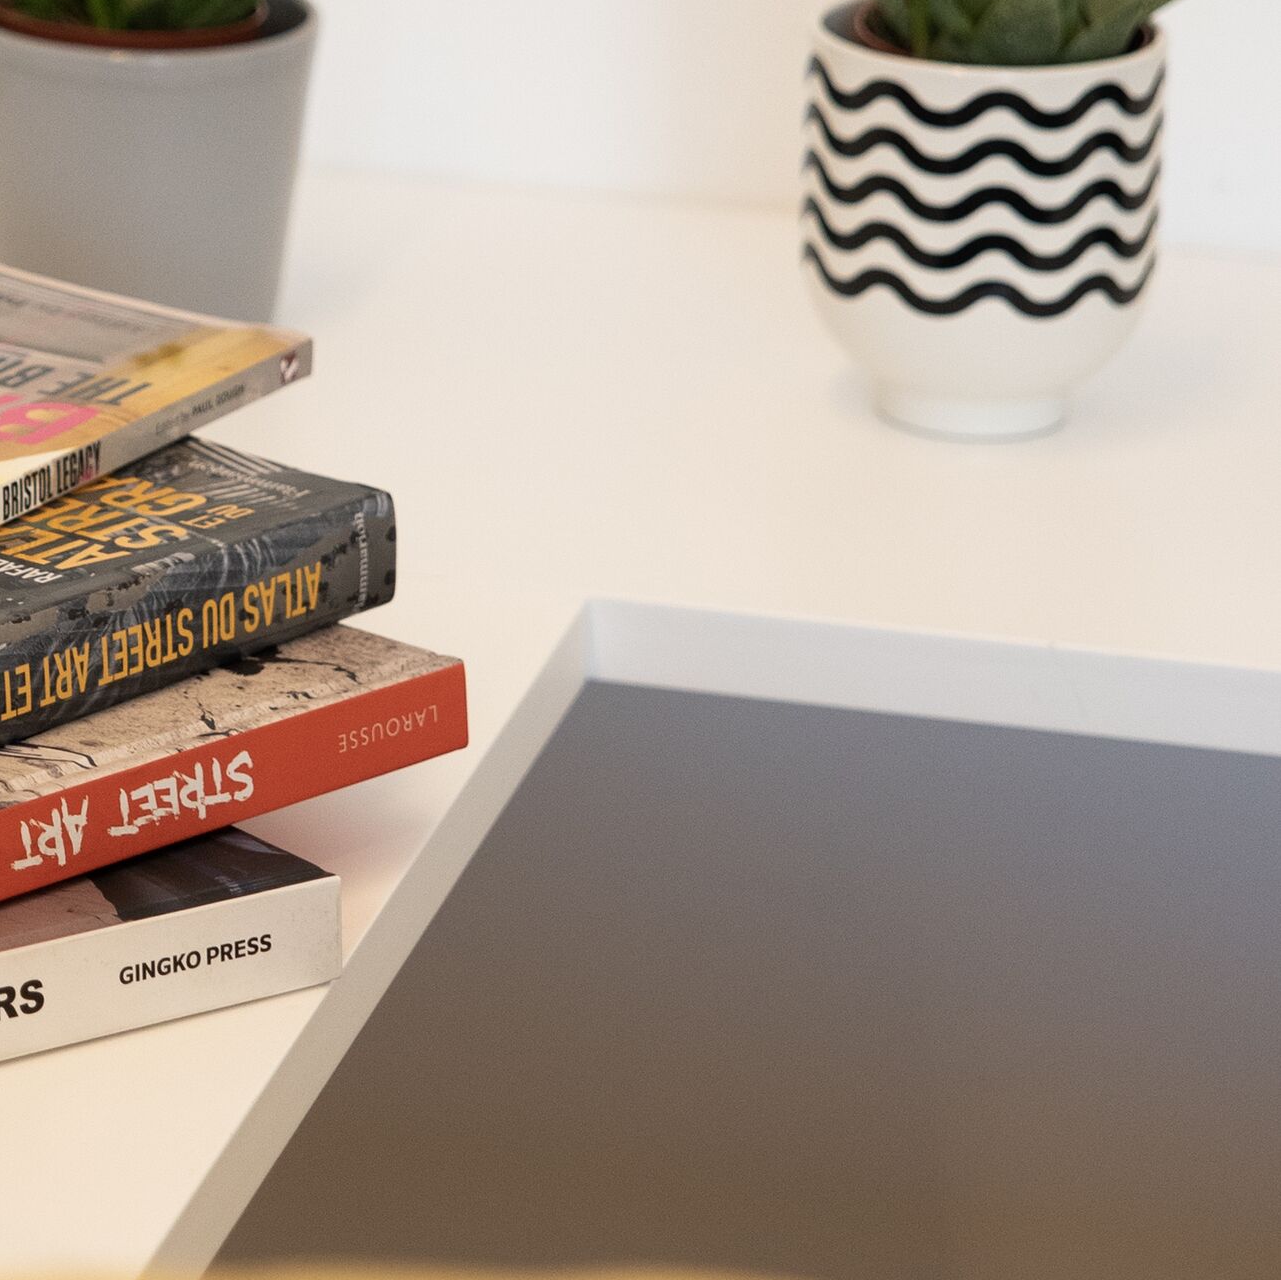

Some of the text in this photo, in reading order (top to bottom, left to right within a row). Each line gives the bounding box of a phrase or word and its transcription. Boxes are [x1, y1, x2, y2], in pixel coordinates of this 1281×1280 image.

[38, 370, 152, 407] THE
[2, 464, 54, 521] BRISTOL
[55, 441, 102, 489] LEGACY
[22, 497, 189, 550] STRE
[206, 503, 255, 520] DU
[202, 592, 237, 649] DU
[242, 560, 322, 634] ATLAS
[39, 641, 90, 708] ART
[97, 607, 195, 687] STREET
[0, 663, 33, 722] ET
[338, 704, 438, 754] LAROUSSE
[10, 750, 255, 871] STREET ART
[118, 934, 272, 985] GINGKO PRESS
